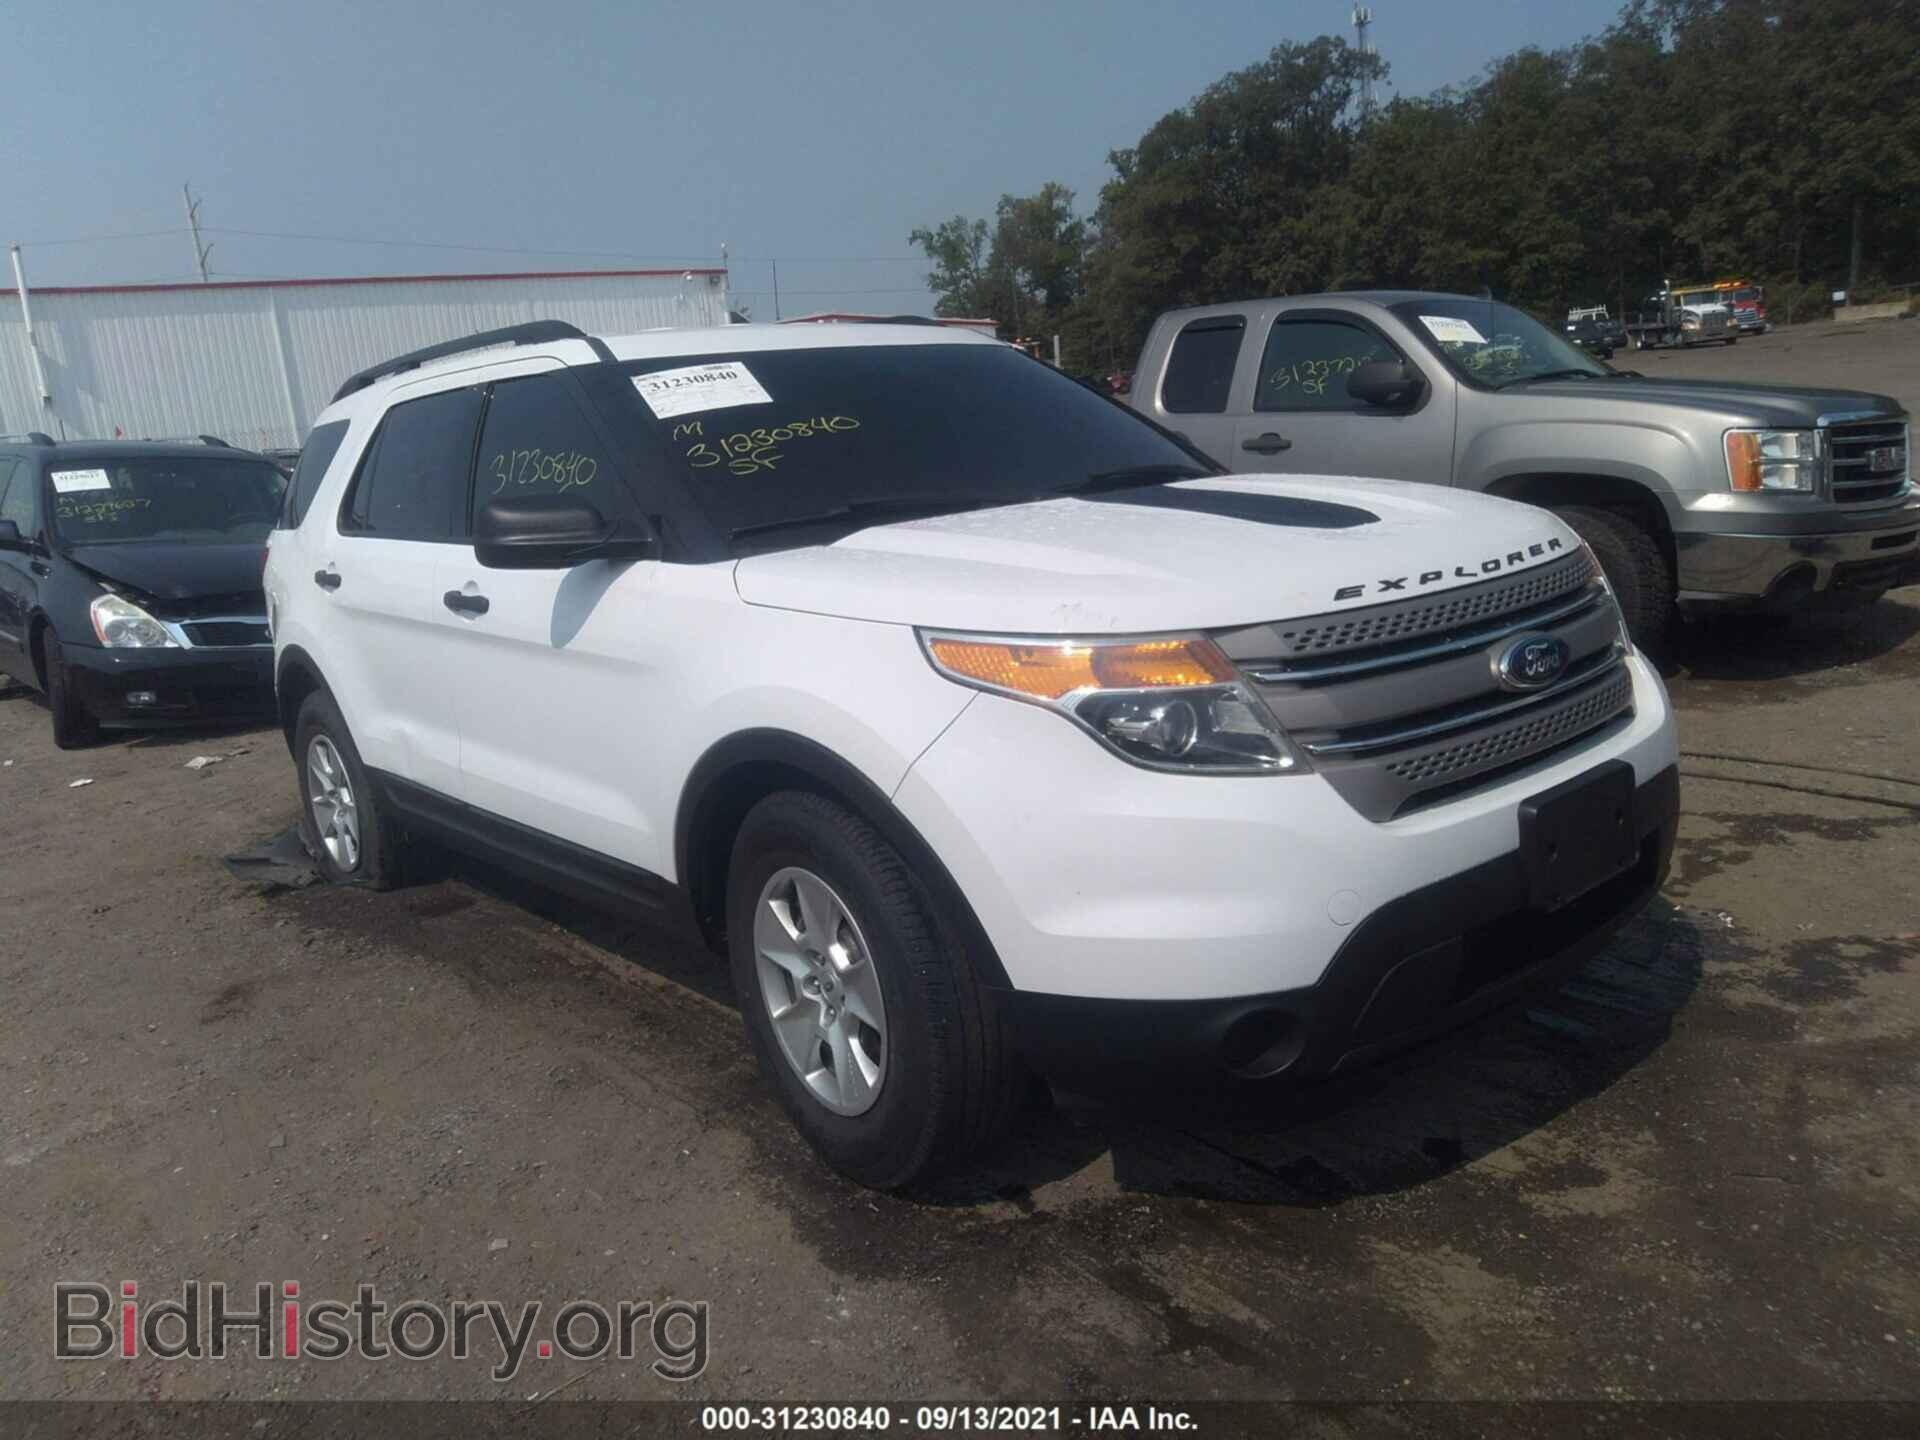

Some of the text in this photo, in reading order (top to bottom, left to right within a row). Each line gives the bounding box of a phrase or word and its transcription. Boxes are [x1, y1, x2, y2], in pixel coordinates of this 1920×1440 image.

[649, 370, 738, 393] 31230840
[686, 416, 861, 467] 31230840
[489, 448, 597, 495] 31230840
[1333, 537, 1563, 601] EXPLORER
[1525, 642, 1560, 676] Ford
